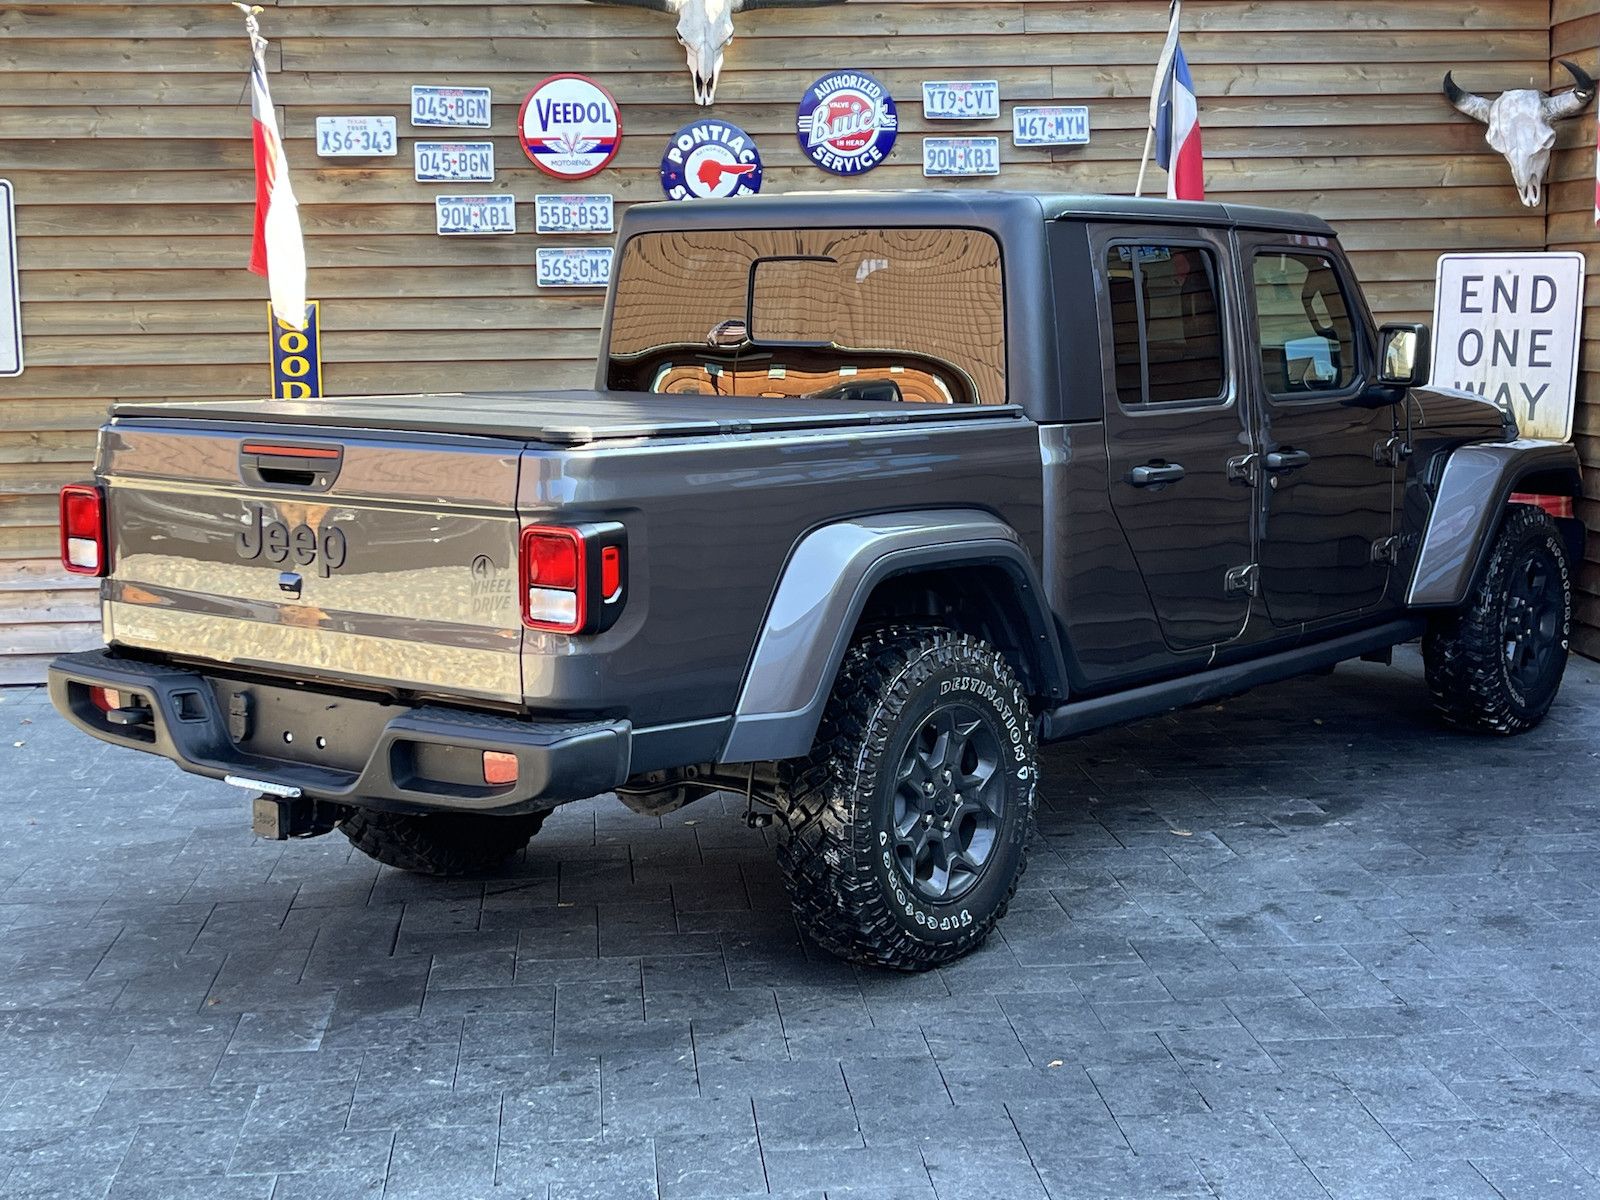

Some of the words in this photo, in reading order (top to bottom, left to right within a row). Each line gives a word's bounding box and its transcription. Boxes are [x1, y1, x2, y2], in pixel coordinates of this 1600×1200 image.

[814, 75, 880, 100] AUTHORIZED
[536, 98, 611, 132] VEEDOL
[807, 96, 891, 148] Buick
[668, 125, 755, 164] PONTIAC
[812, 145, 882, 172] SERVICE
[1460, 275, 1557, 314] END
[1457, 328, 1553, 368] ONE
[235, 507, 346, 578] Jeep
[471, 579, 512, 596] WHEEL
[473, 595, 512, 614] DRIVE
[940, 676, 1026, 762] DESTINATION
